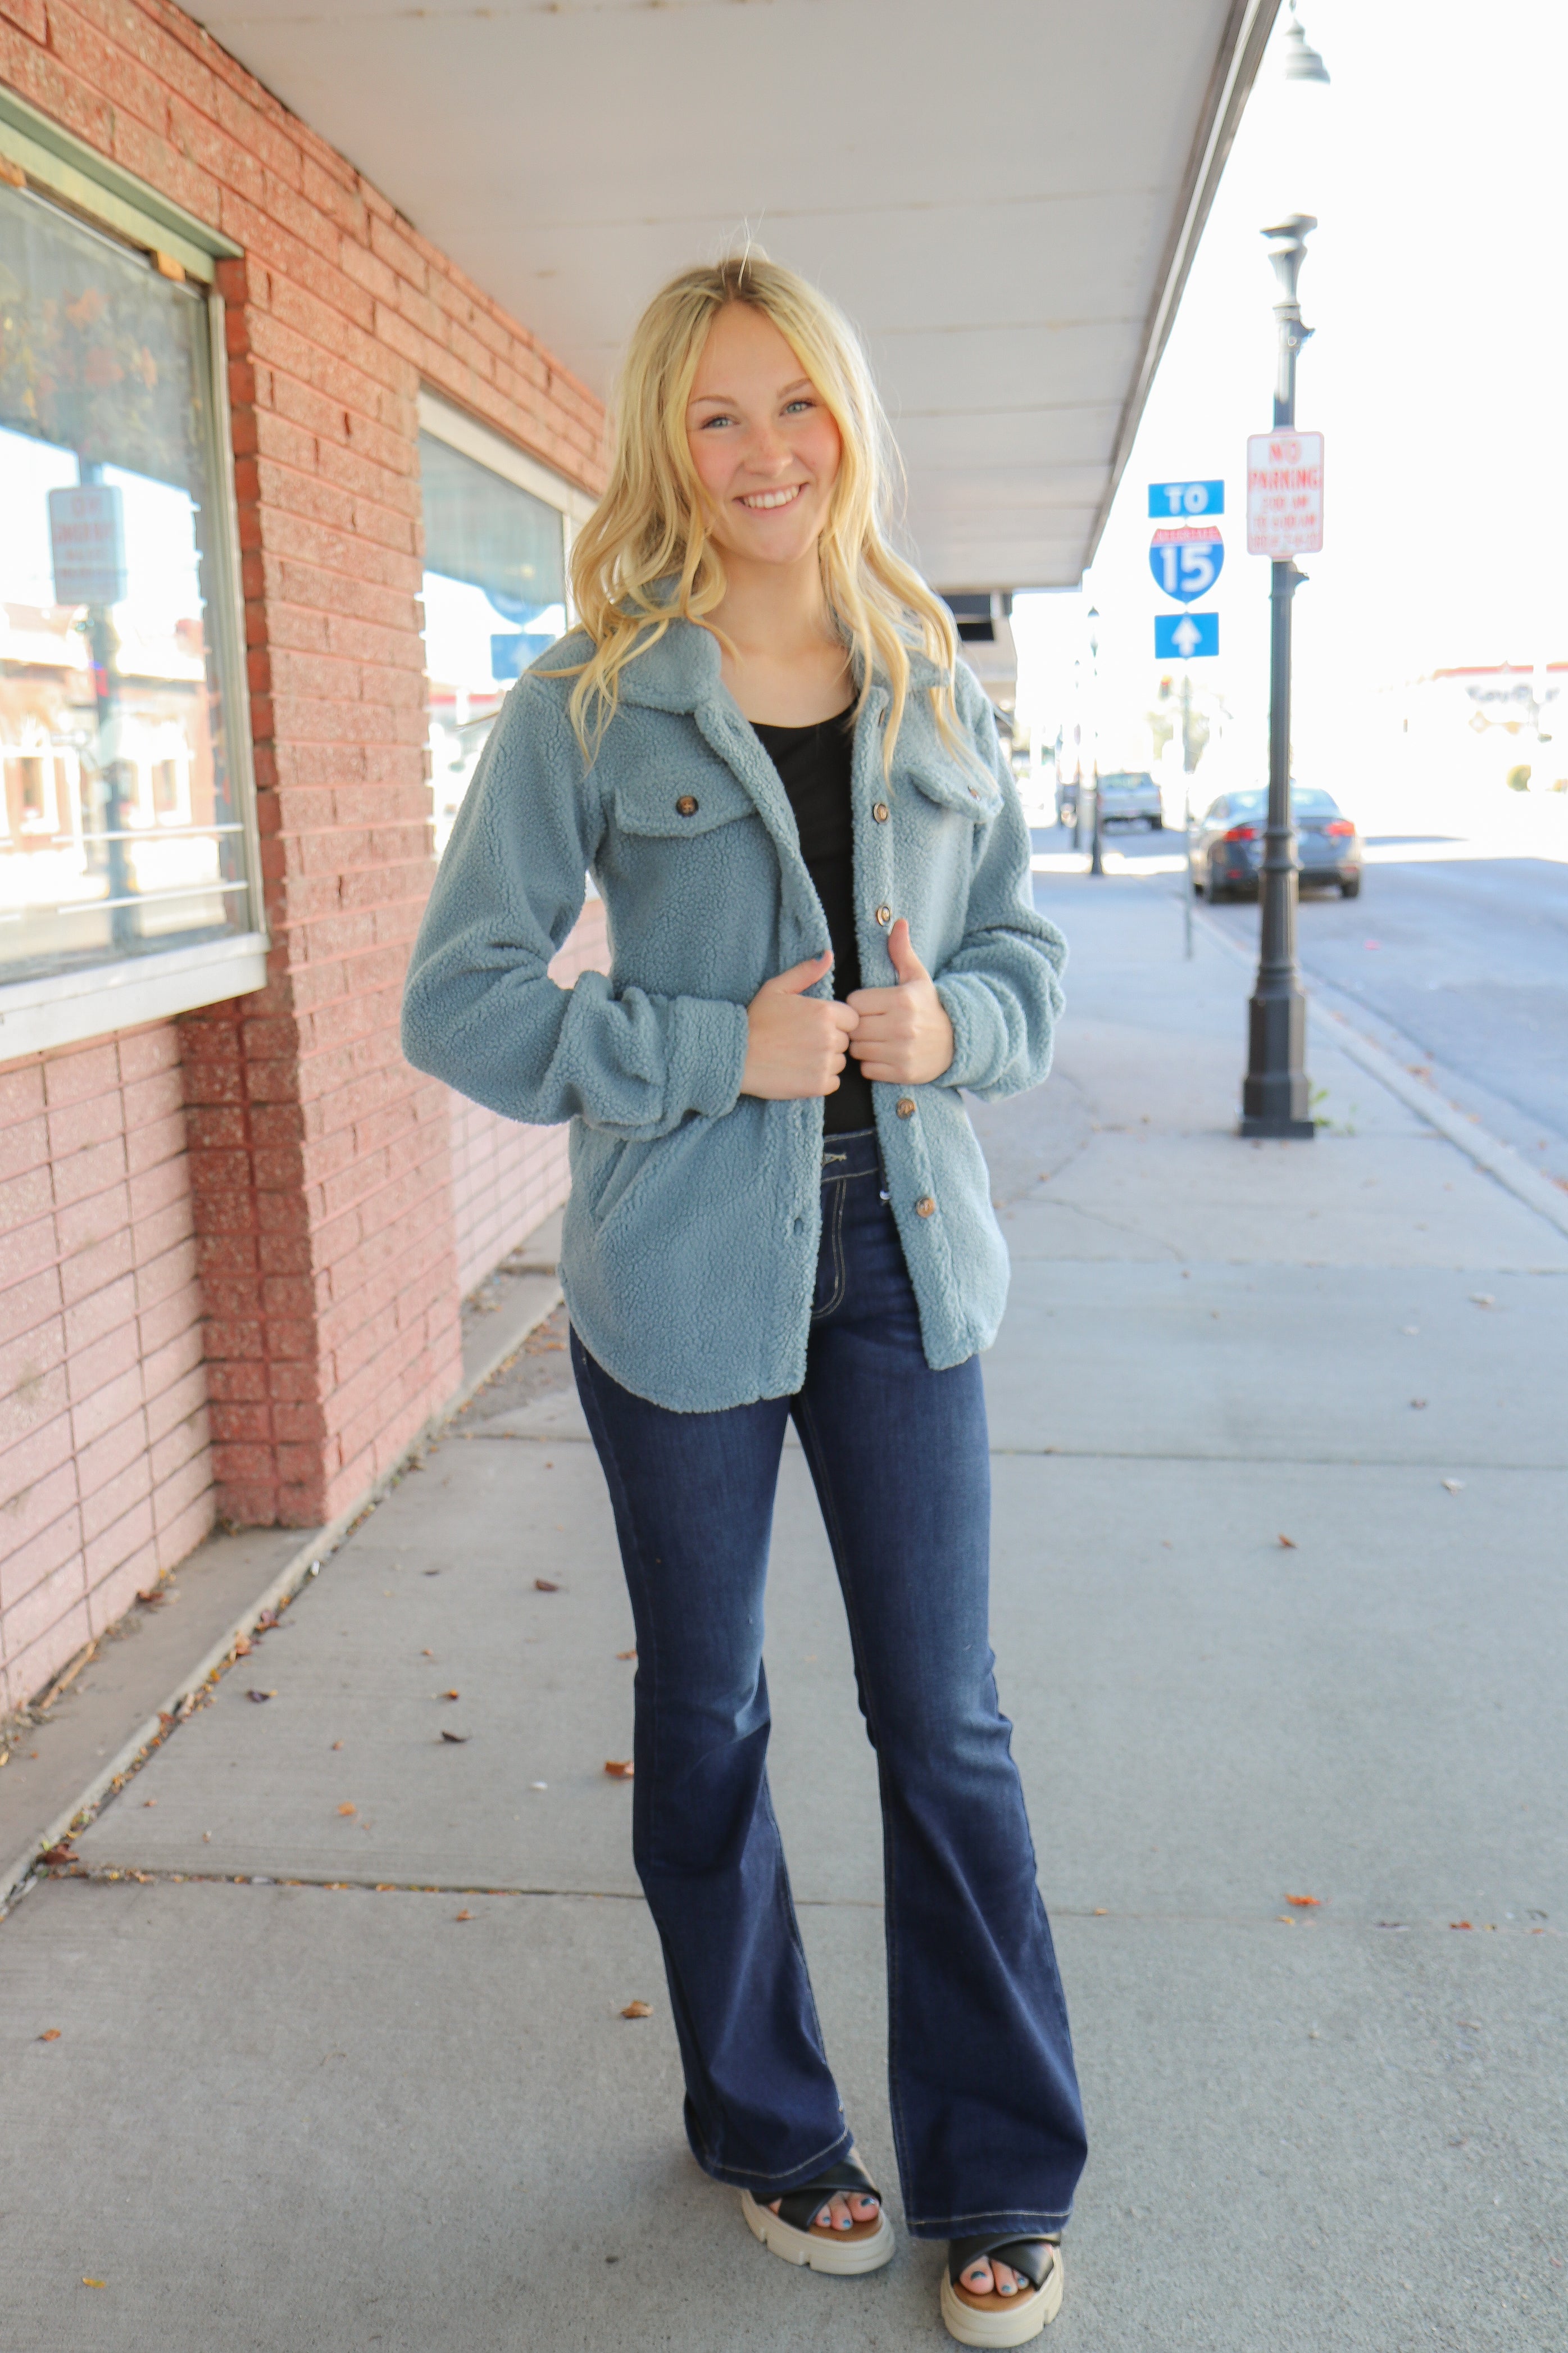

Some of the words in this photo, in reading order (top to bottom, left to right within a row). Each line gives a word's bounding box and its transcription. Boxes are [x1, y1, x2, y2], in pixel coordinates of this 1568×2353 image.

[1268, 440, 1302, 465] NO
[1248, 466, 1319, 492] PARKING
[1163, 483, 1209, 515] TO
[1159, 544, 1215, 593] 15
